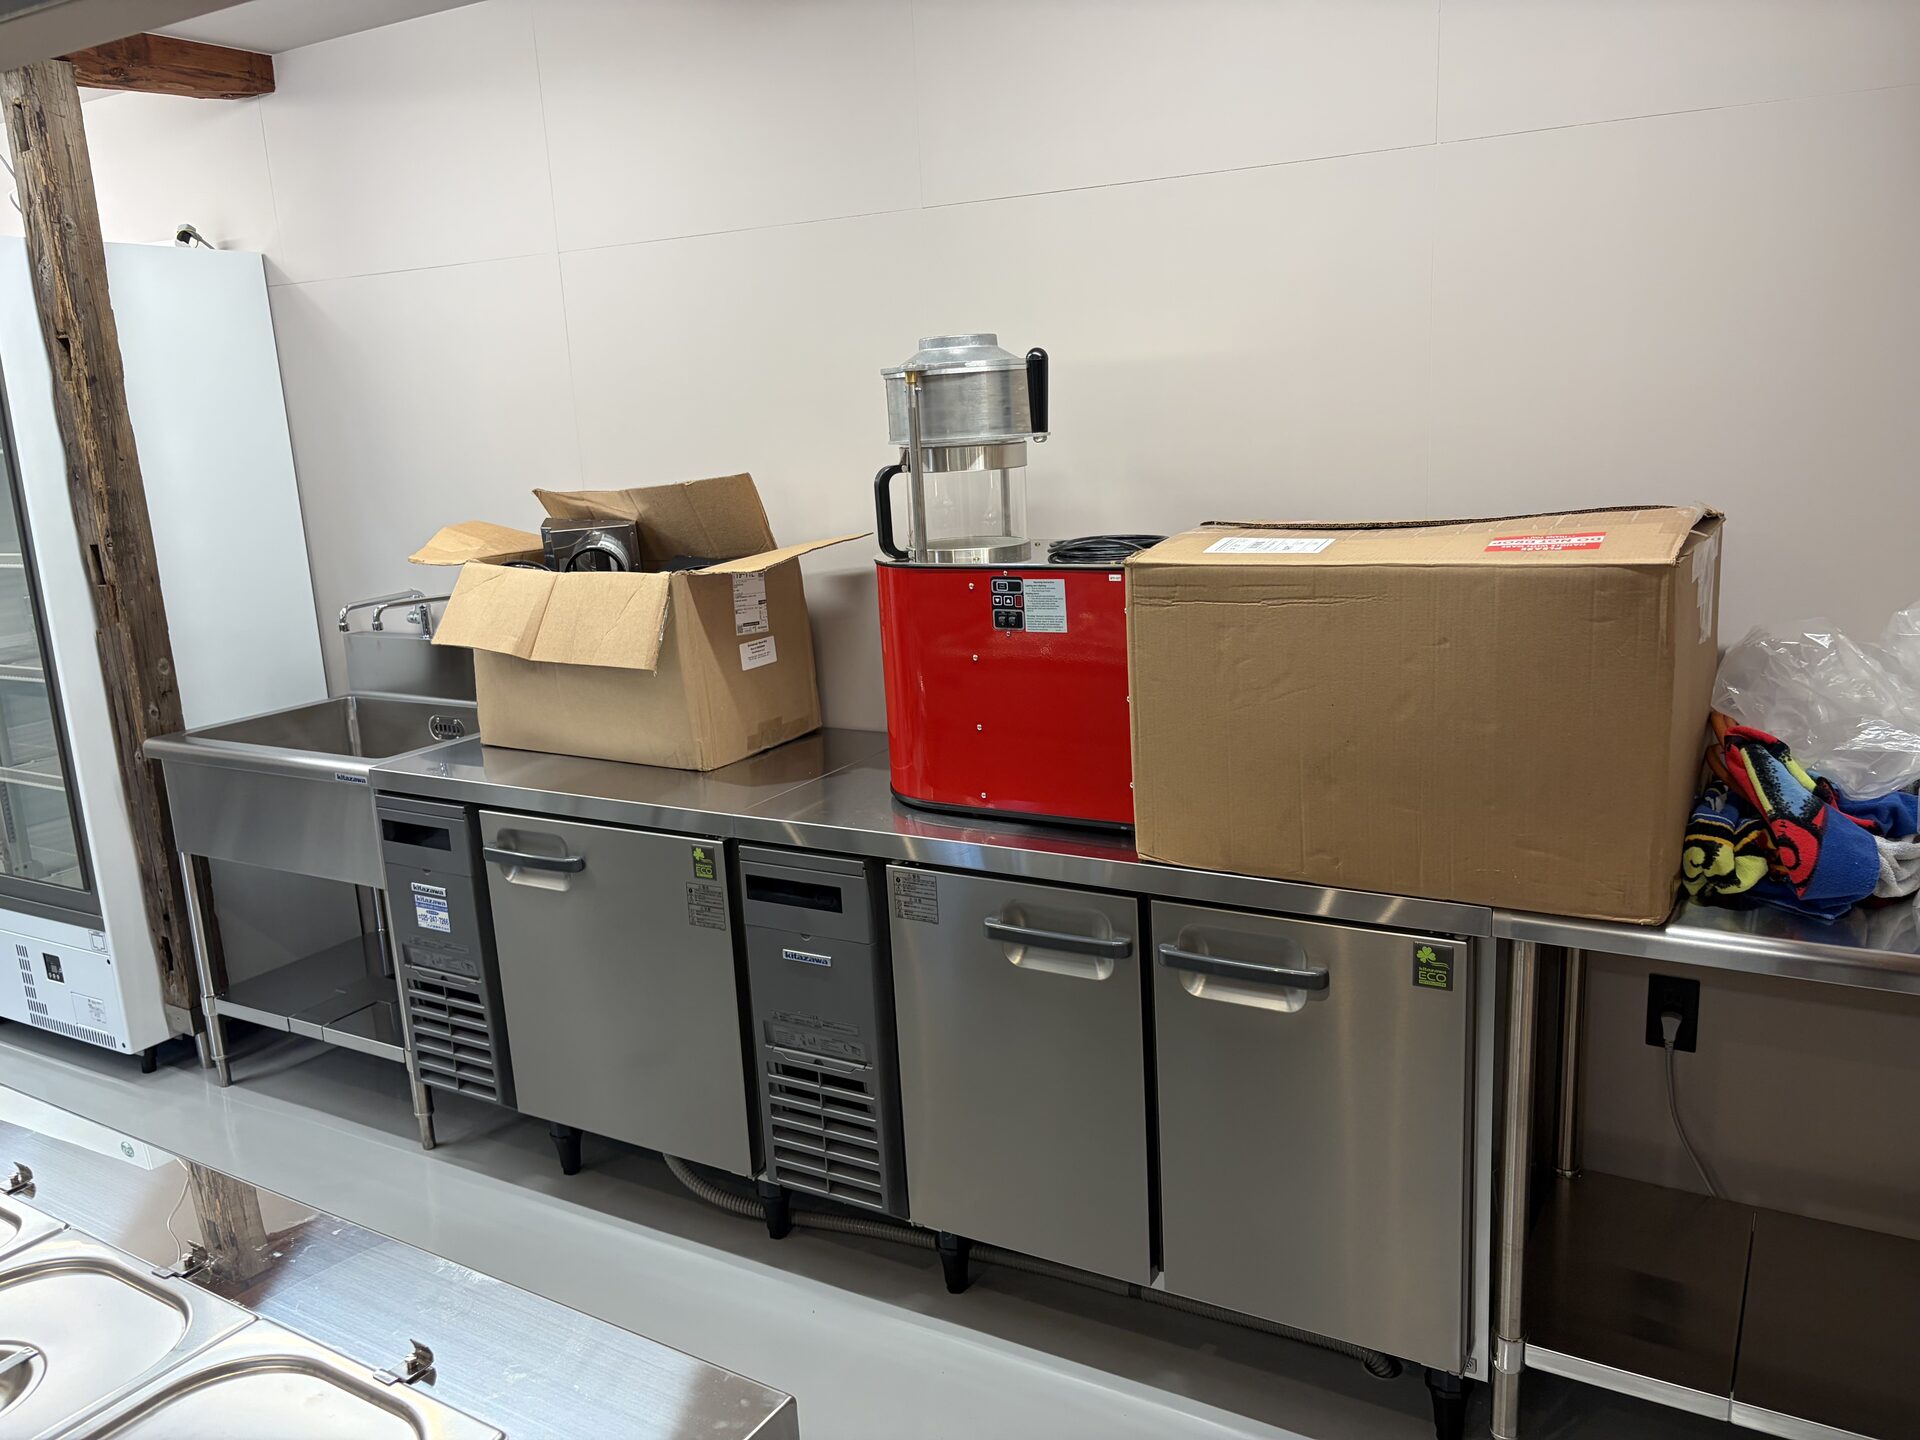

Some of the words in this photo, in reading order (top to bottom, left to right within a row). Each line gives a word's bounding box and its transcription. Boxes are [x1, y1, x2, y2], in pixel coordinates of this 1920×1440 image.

[412, 883, 445, 896] kitazawa
[784, 950, 829, 966] kitazawa
[1418, 970, 1447, 983] ECO
